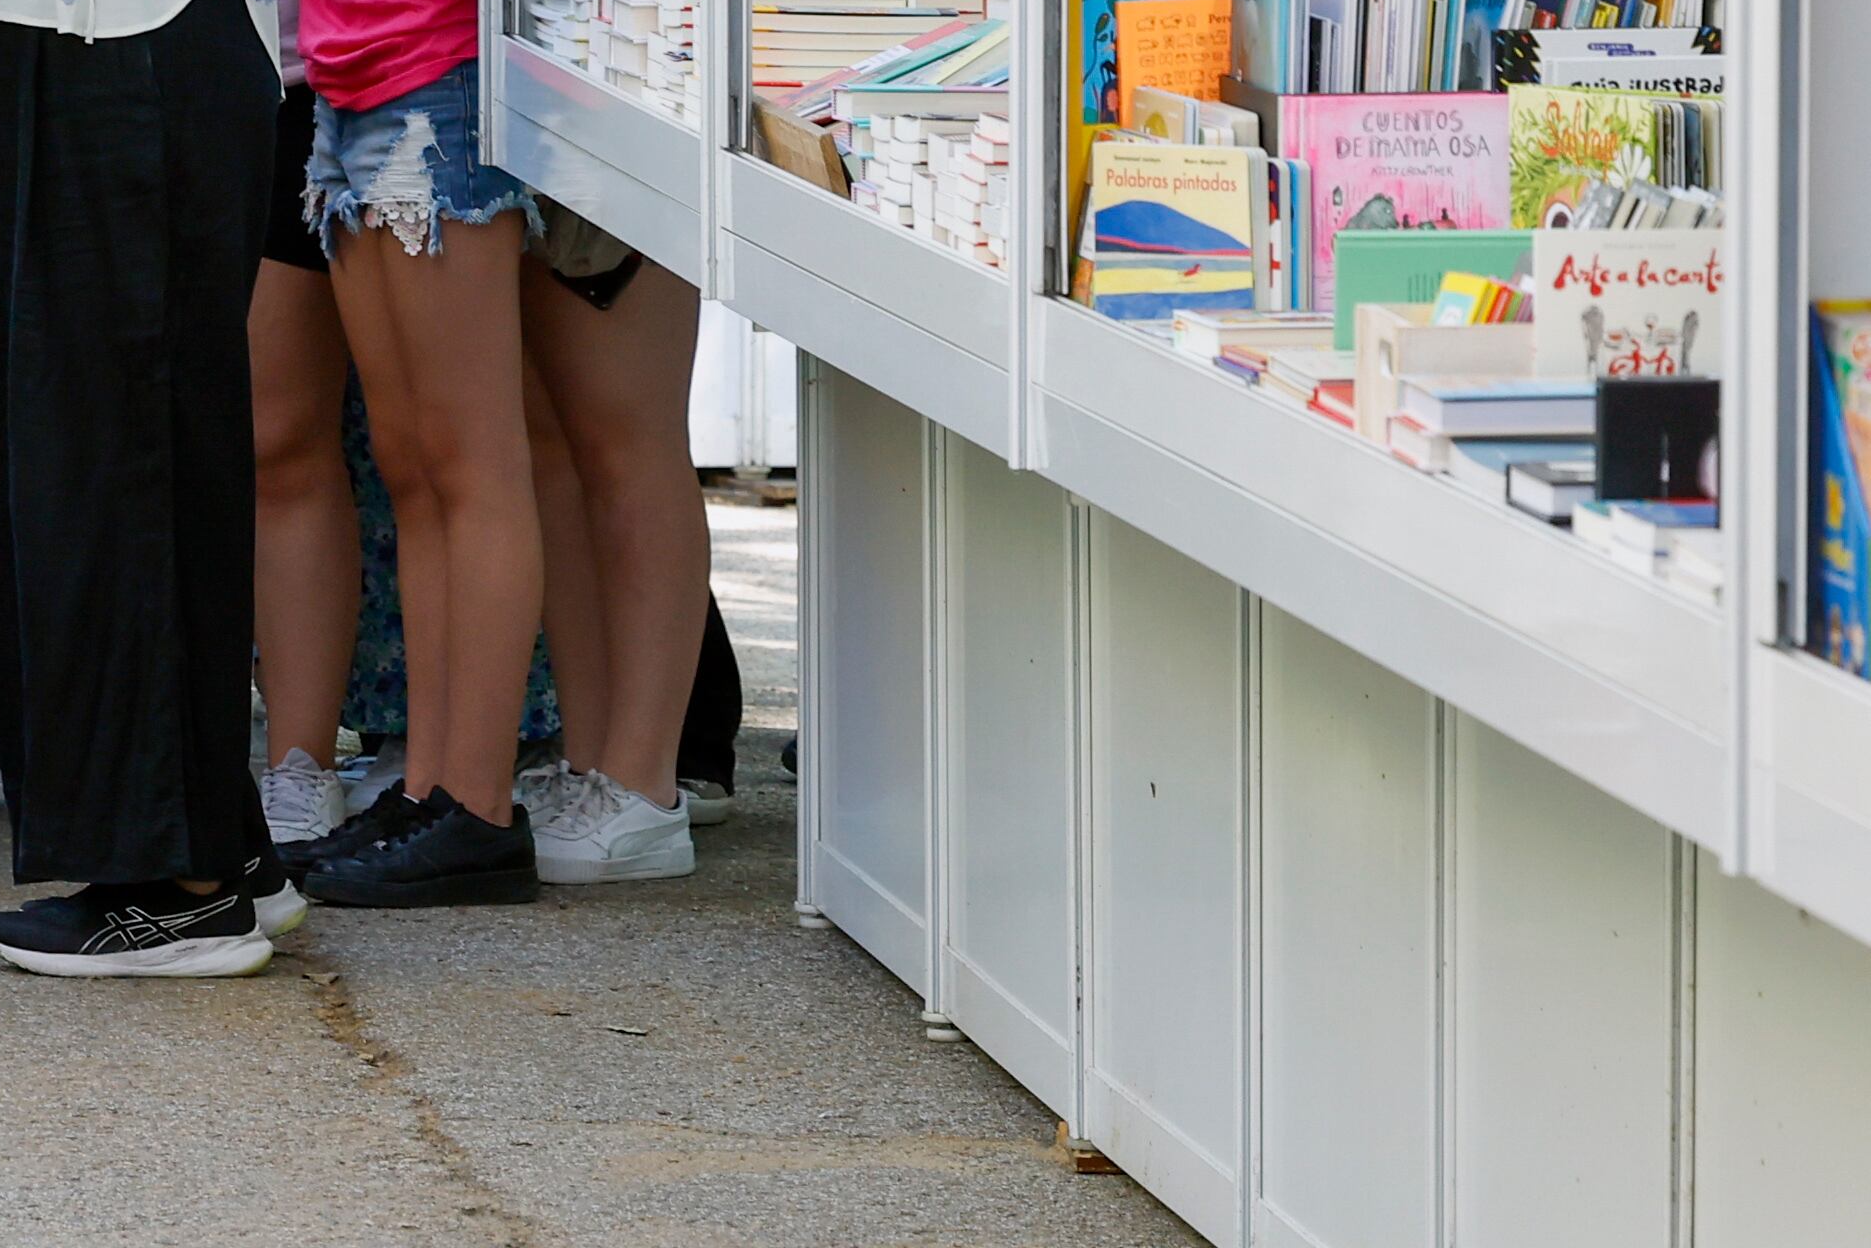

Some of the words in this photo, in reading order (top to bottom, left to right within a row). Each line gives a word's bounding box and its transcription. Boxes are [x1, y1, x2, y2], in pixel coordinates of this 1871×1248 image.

[1362, 110, 1464, 133] CUENTOS
[1335, 136, 1365, 159] DE
[1448, 135, 1492, 158] OSA
[1106, 168, 1169, 190] Palabras
[1173, 172, 1237, 196] pintadas
[1553, 254, 1611, 297] Arte
[1617, 271, 1629, 283] a
[1636, 260, 1660, 286] la
